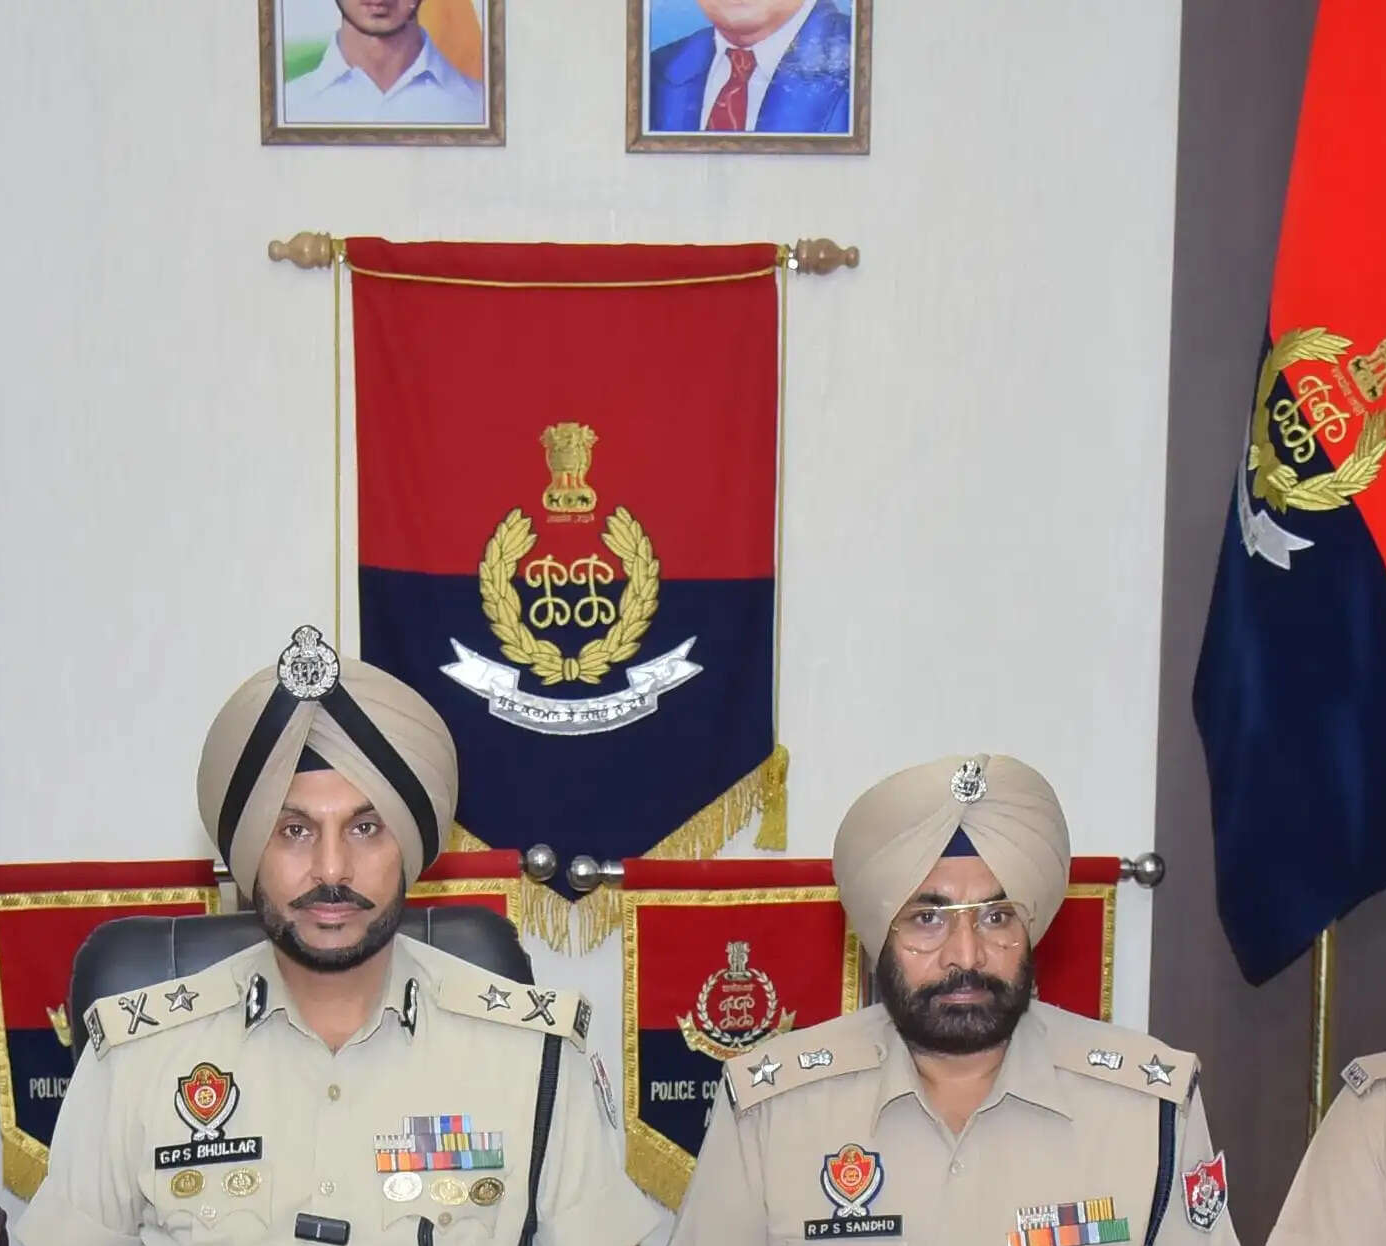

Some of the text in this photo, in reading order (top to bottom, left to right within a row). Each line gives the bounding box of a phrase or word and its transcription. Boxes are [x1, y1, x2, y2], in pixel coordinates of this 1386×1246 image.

[651, 1081, 696, 1101] POLICE
[196, 1139, 256, 1159] BHULLAR
[846, 1219, 895, 1232] SANDHU
